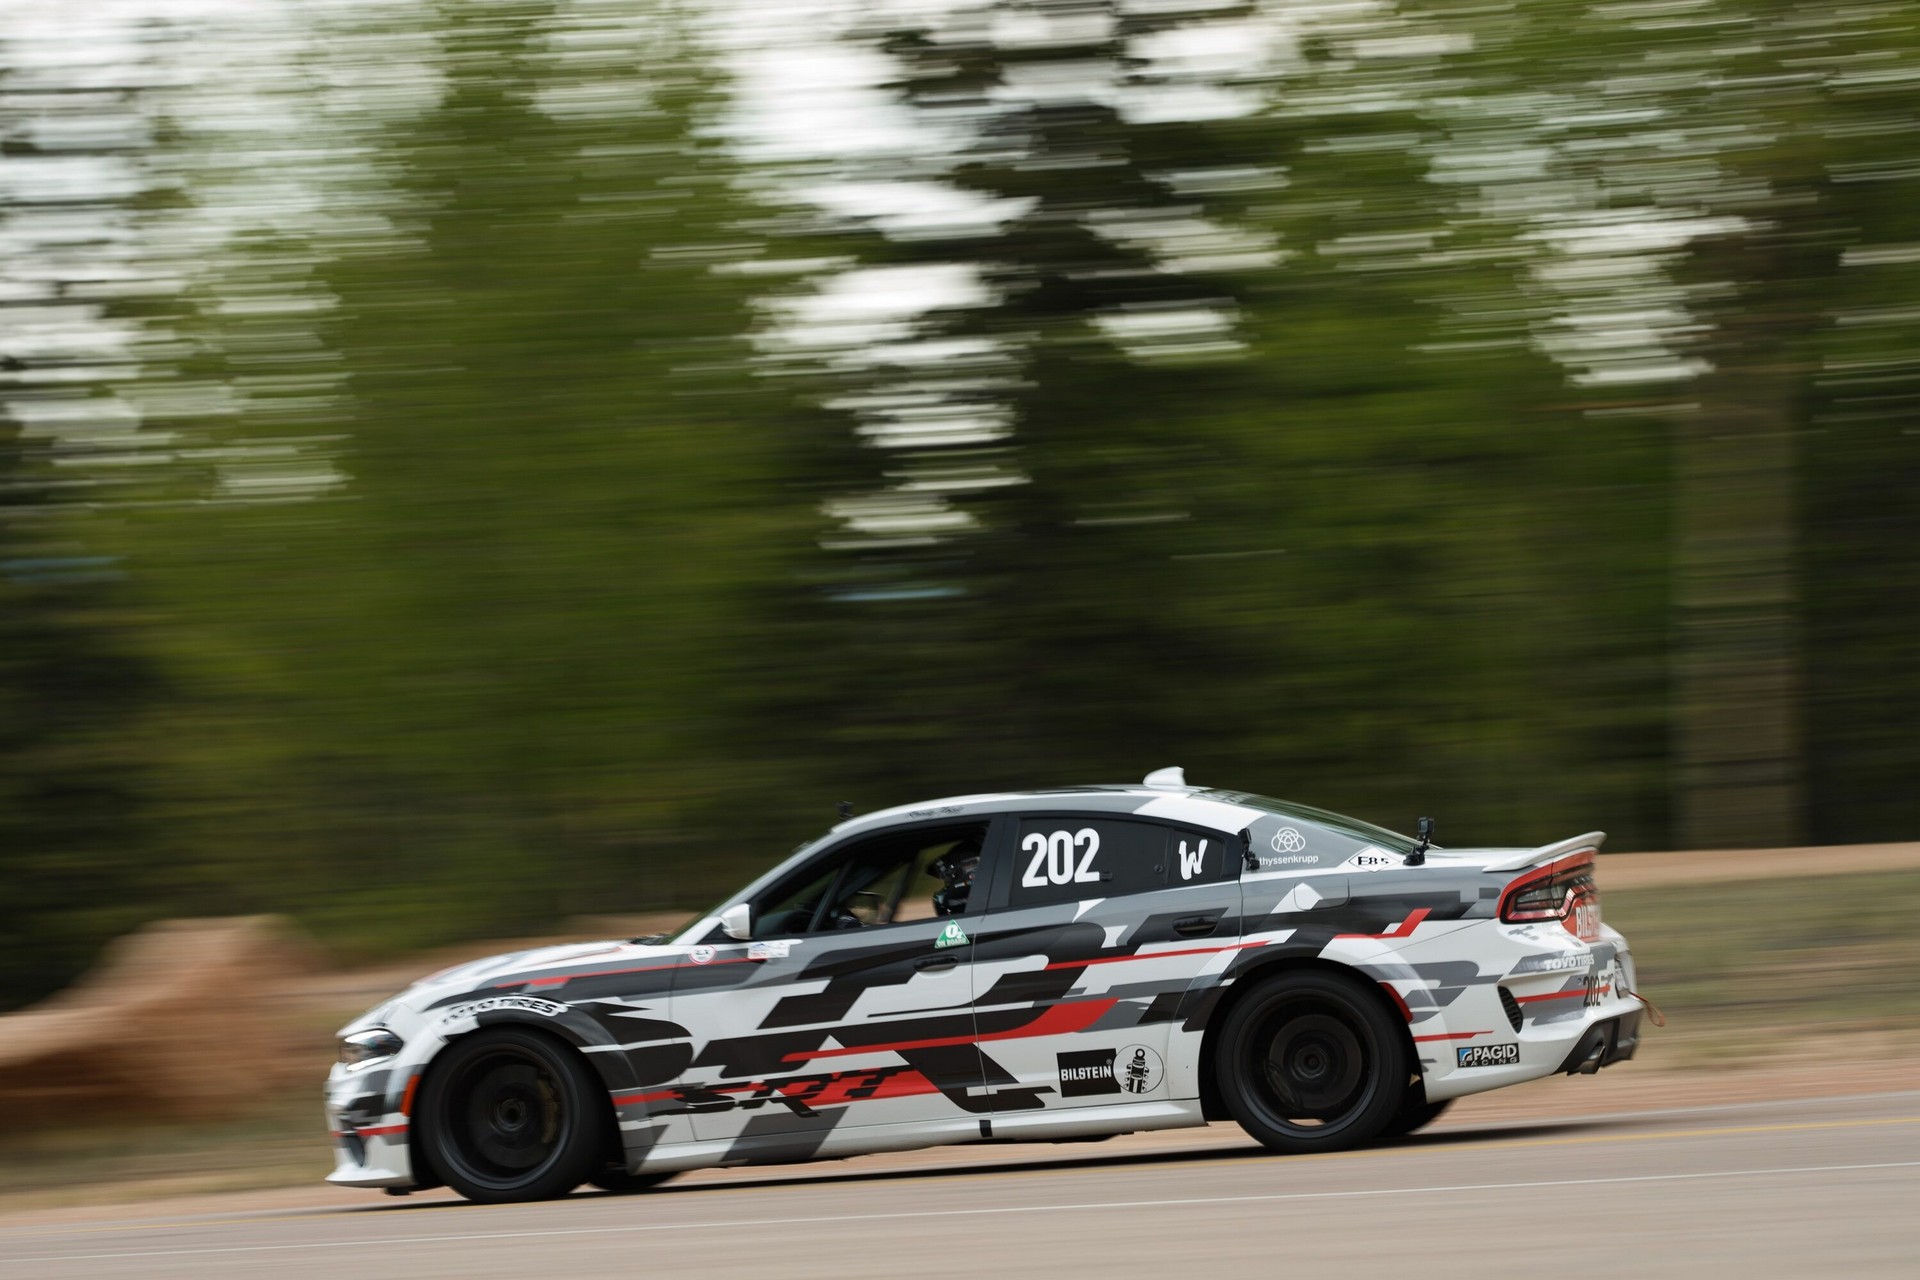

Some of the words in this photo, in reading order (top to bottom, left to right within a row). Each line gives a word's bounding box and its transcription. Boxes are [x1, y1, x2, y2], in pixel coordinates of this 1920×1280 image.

[1021, 827, 1100, 888] 202
[1178, 838, 1208, 881] W
[1259, 854, 1319, 867] thyssenkrupp
[1543, 956, 1575, 971] TOYO
[1575, 953, 1595, 967] TIRES
[1582, 975, 1601, 1007] 202
[1473, 1044, 1518, 1061] PAGID
[1459, 1056, 1518, 1068] RACING
[1060, 1064, 1112, 1082] BILSTEIN
